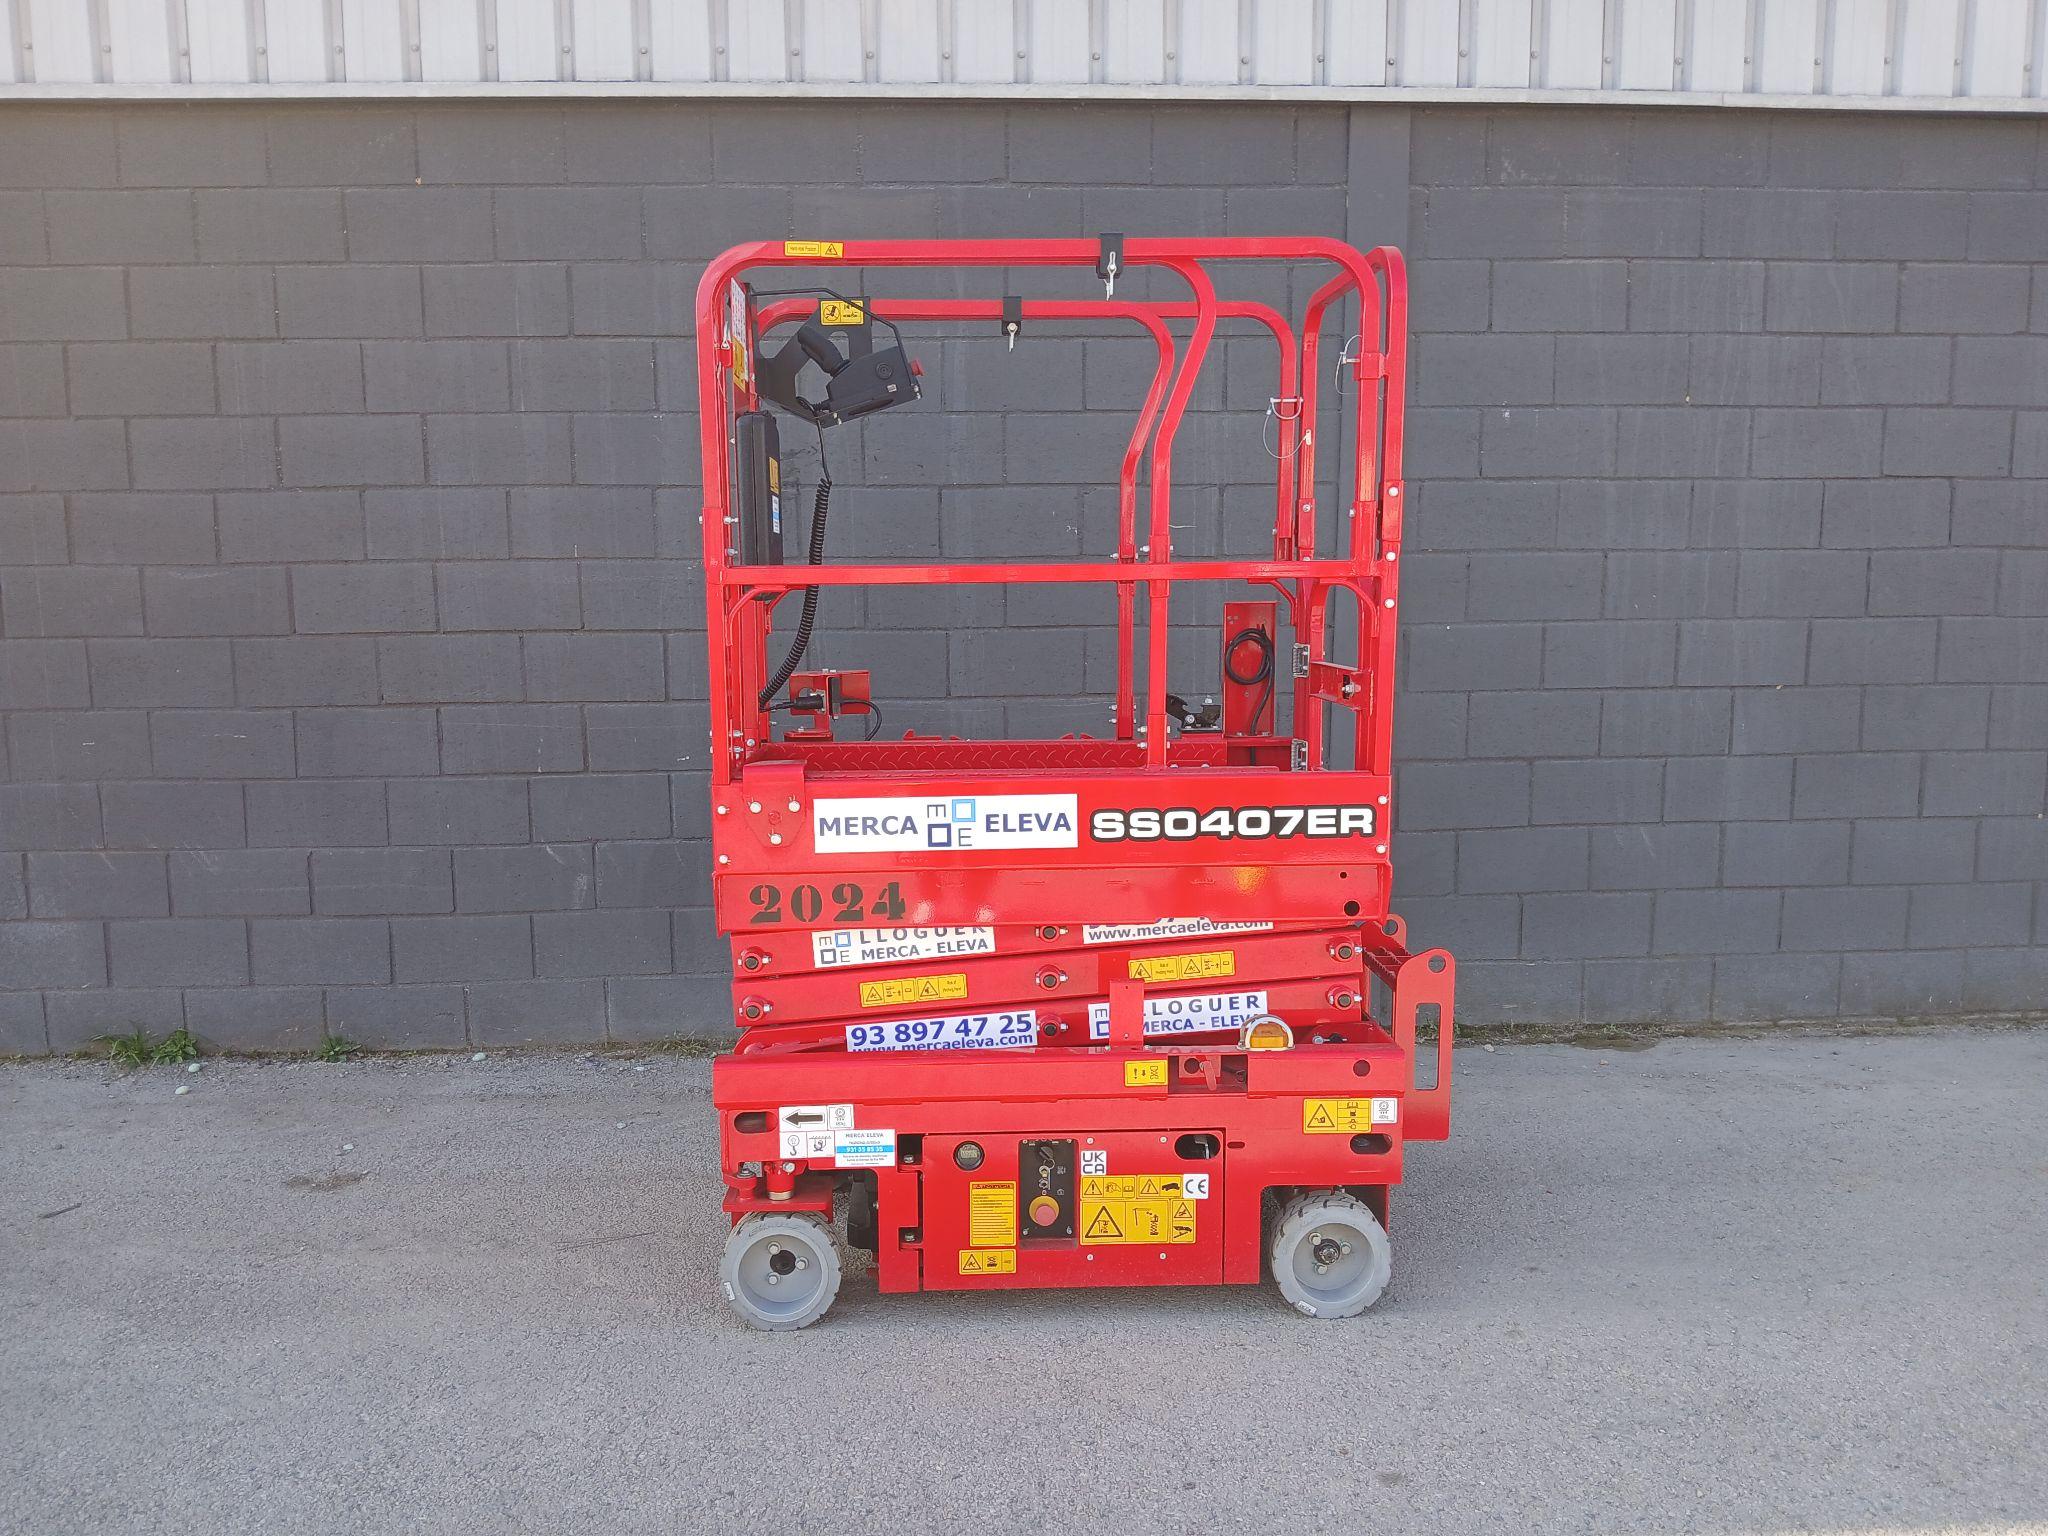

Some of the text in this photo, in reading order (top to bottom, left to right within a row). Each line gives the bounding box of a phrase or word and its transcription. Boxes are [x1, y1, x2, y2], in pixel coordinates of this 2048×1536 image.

[819, 812, 1071, 836] MERCA ELEVA
[1091, 804, 1376, 841] SS0407ER
[749, 881, 906, 924] 2024
[861, 945, 920, 961] MERCA
[937, 938, 988, 953] ELEVA
[1143, 995, 1261, 1016] LOGUER
[850, 1013, 1031, 1047] 93 897 47 25
[1211, 1014, 1251, 1028] ELEV
[1082, 1151, 1105, 1162] UK
[1082, 1163, 1105, 1174] CA
[1185, 1179, 1207, 1194] CE
